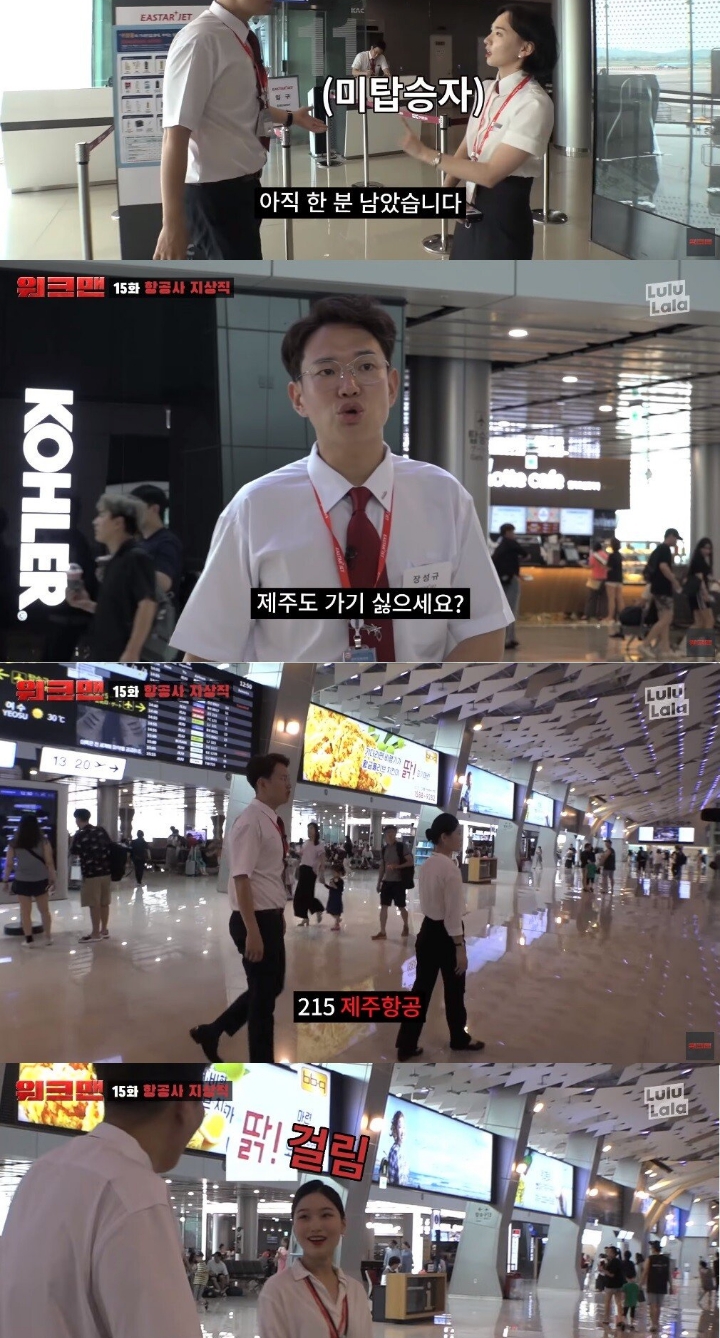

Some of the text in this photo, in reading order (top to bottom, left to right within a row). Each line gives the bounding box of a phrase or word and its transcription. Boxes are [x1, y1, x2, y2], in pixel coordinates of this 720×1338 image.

[140, 13, 193, 22] EASTAR JET
[18, 387, 74, 611] KOHLER
[412, 571, 440, 584] 장성규
[2, 708, 29, 721] YEOSU
[53, 755, 91, 770] 13 20
